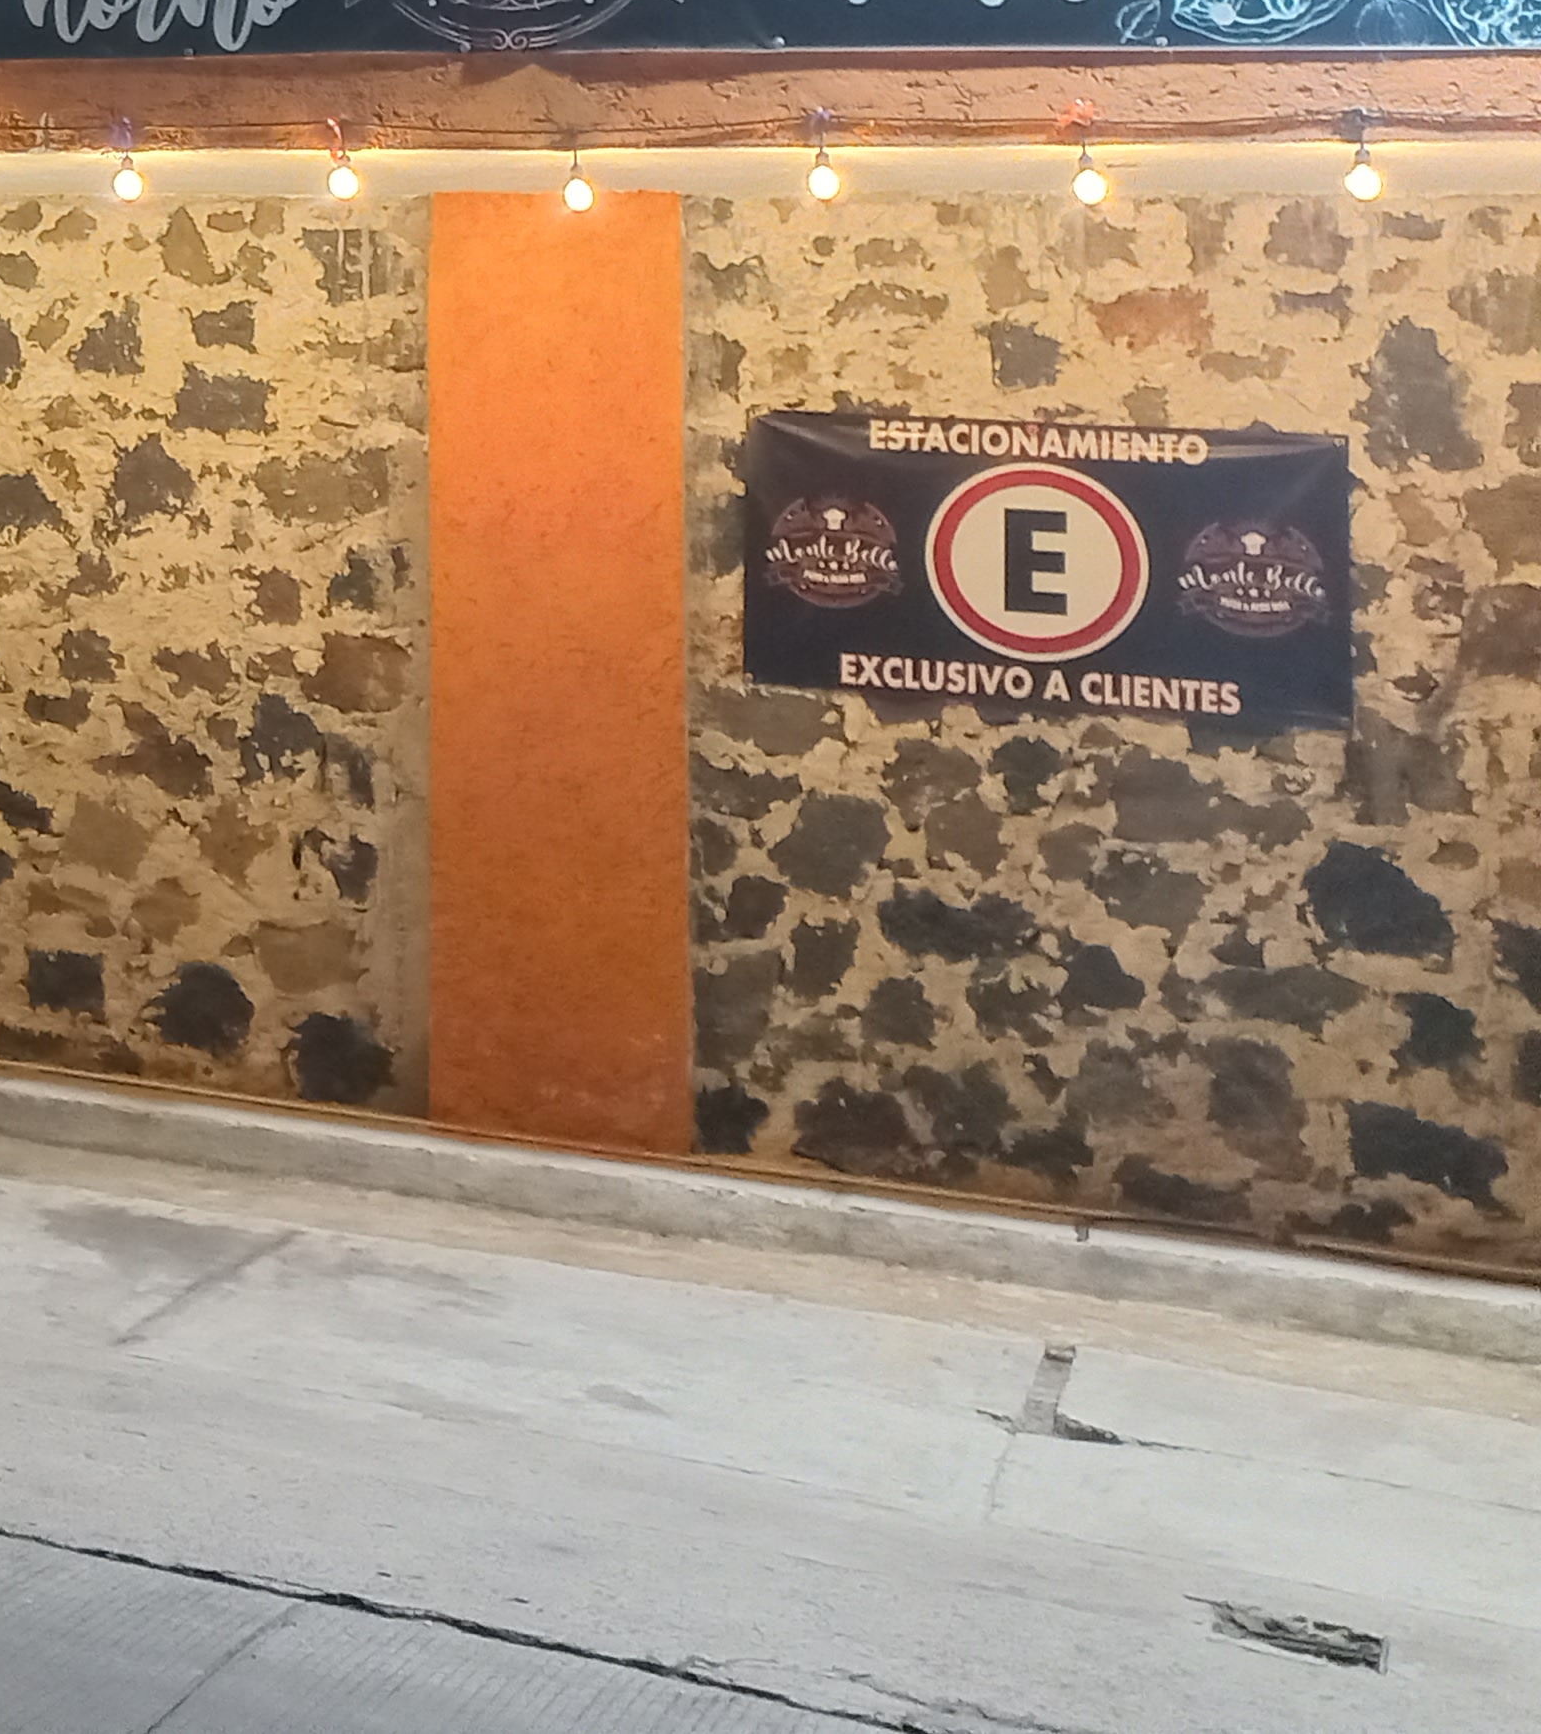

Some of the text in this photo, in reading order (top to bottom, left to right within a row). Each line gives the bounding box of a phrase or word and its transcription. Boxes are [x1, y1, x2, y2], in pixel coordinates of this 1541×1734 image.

[868, 418, 1209, 466] ESTACIONAMIENTO
[1004, 507, 1068, 616] E
[839, 652, 1243, 715] EXCLUSIVO A CLIENTES
